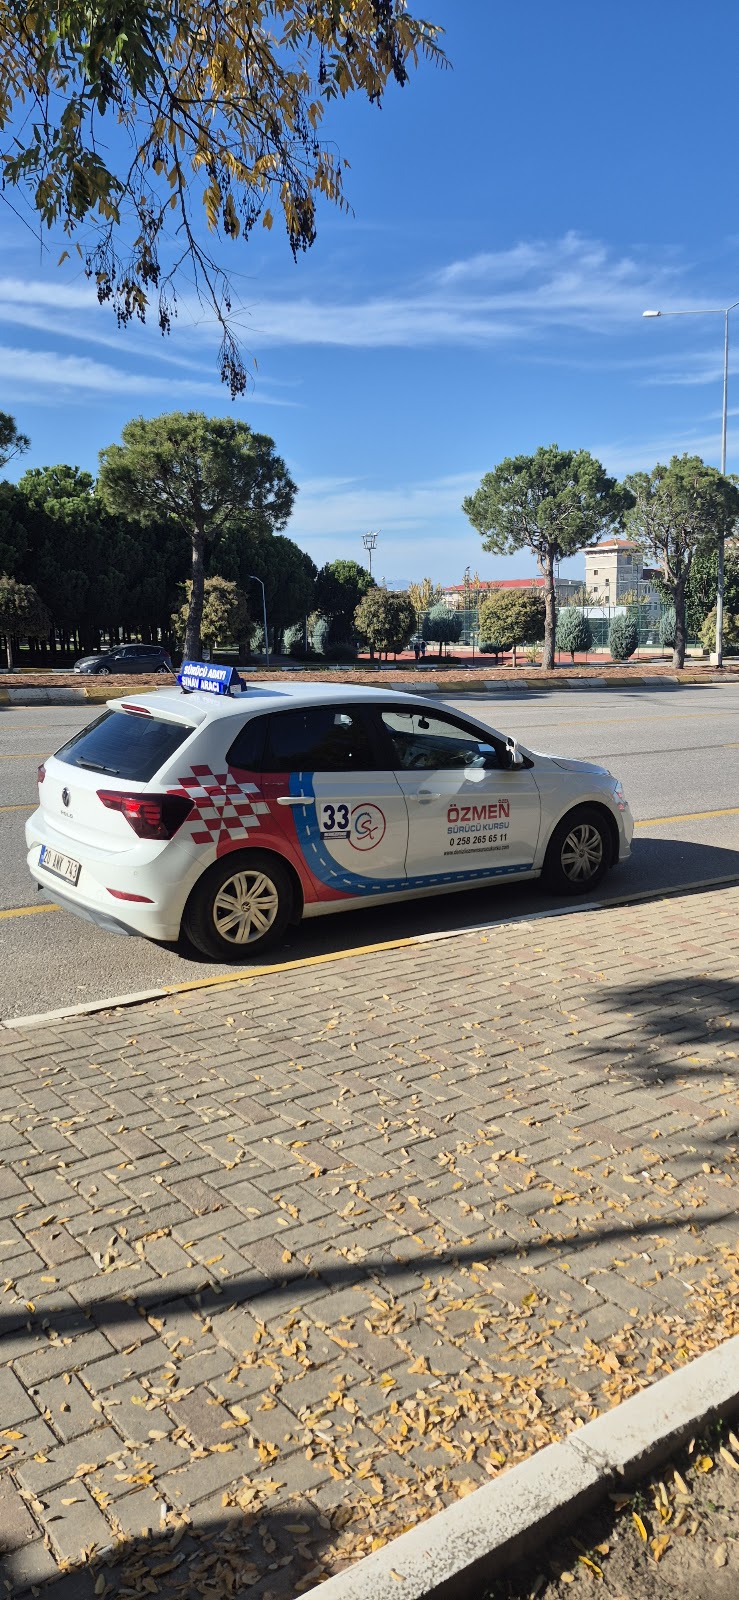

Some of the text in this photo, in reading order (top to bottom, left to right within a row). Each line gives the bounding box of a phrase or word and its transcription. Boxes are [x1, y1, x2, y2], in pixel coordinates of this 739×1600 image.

[184, 664, 226, 680] SÜRÜCÜ ADAYI
[200, 680, 220, 692] ARACI
[323, 804, 349, 830] 33
[447, 803, 510, 823] ÖZMEN
[447, 821, 510, 834] SÜRÜCÜ KURSU
[449, 833, 507, 846] 0 258 265 65 11
[44, 849, 51, 864] 20
[65, 860, 78, 879] 743
